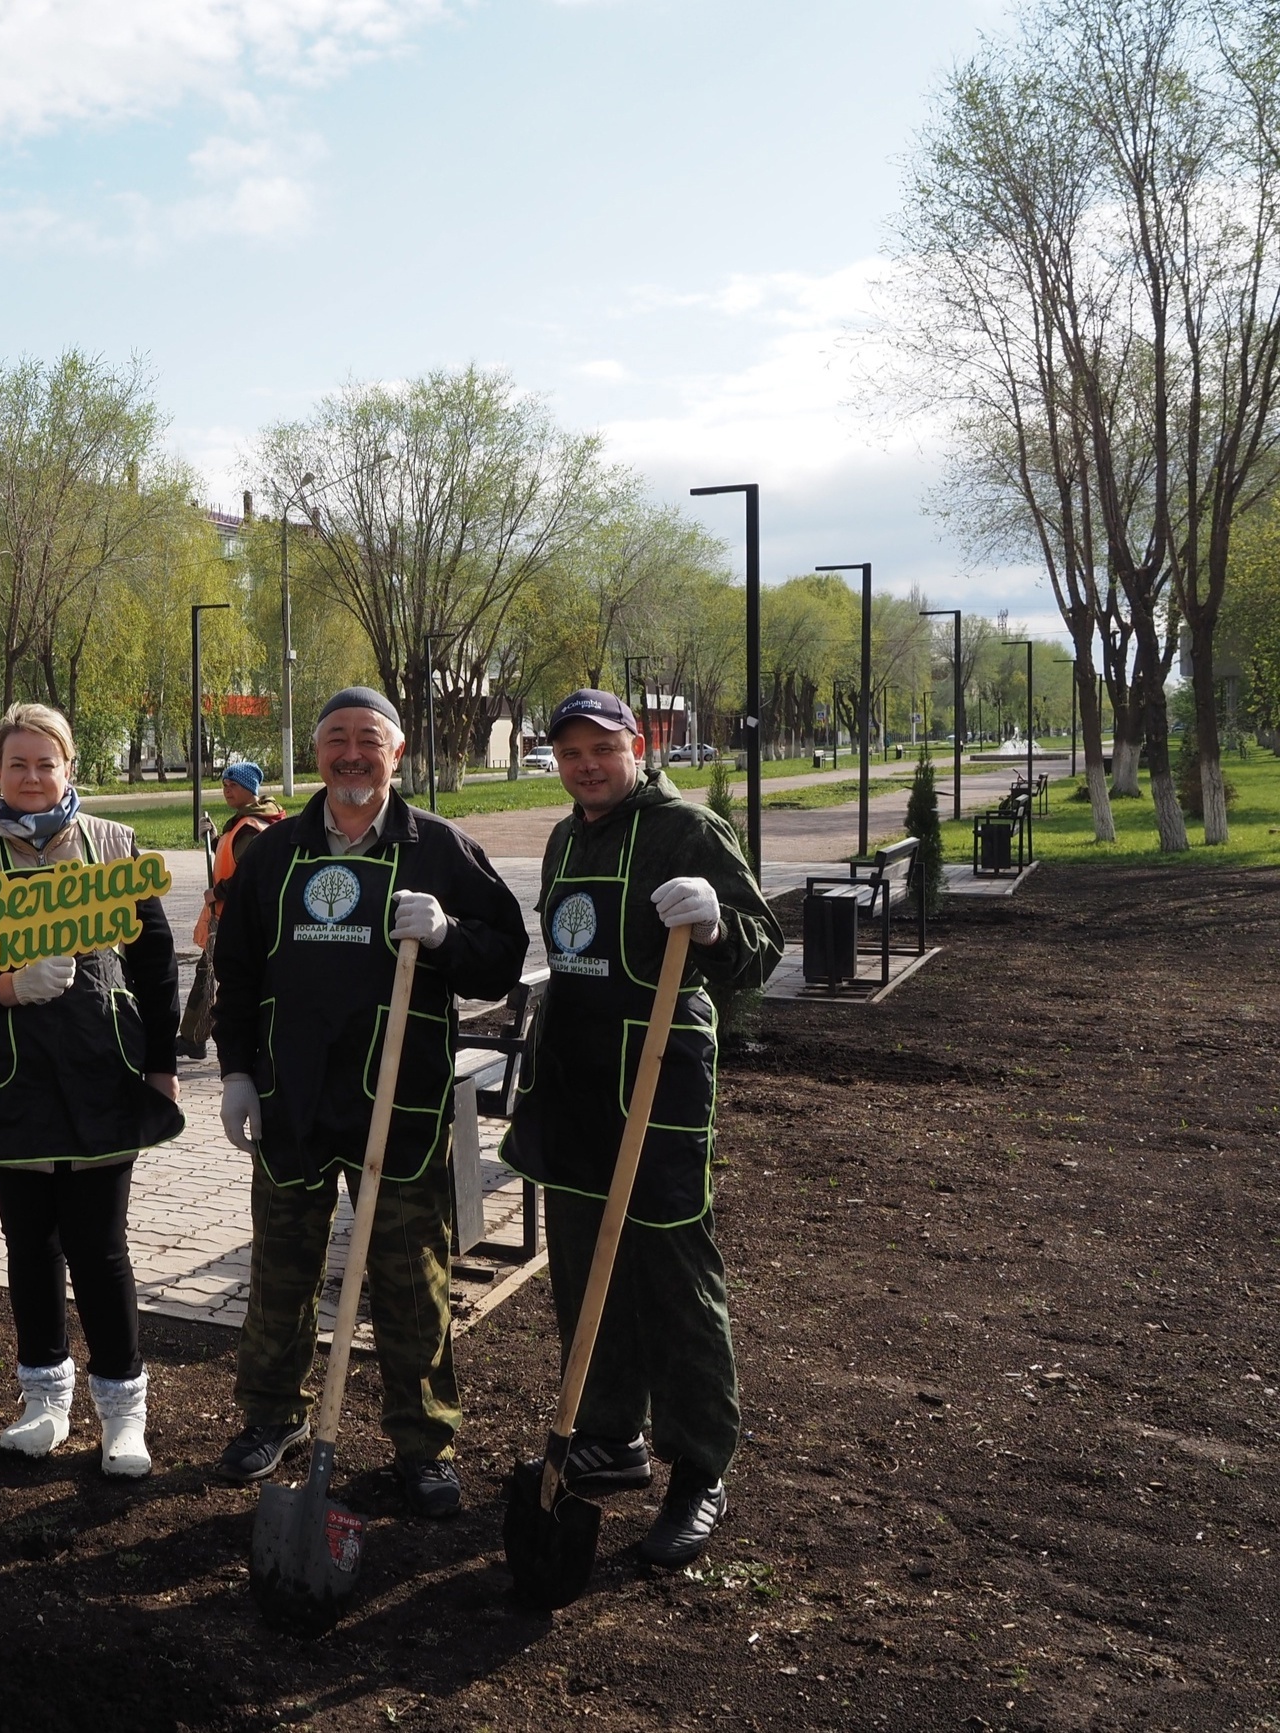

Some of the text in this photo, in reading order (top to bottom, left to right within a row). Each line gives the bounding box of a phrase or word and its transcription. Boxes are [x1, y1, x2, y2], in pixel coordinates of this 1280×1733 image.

[567, 699, 602, 709] Columbia
[294, 924, 327, 932] ПОСАДИ
[329, 925, 363, 933] ДЕРЕВО
[331, 934, 366, 942] ЖИЗНЬ!
[569, 956, 600, 965] ДЕРЕВО
[570, 966, 604, 975] ЖИЗНЬ!
[337, 1515, 362, 1527] ЗУБР
